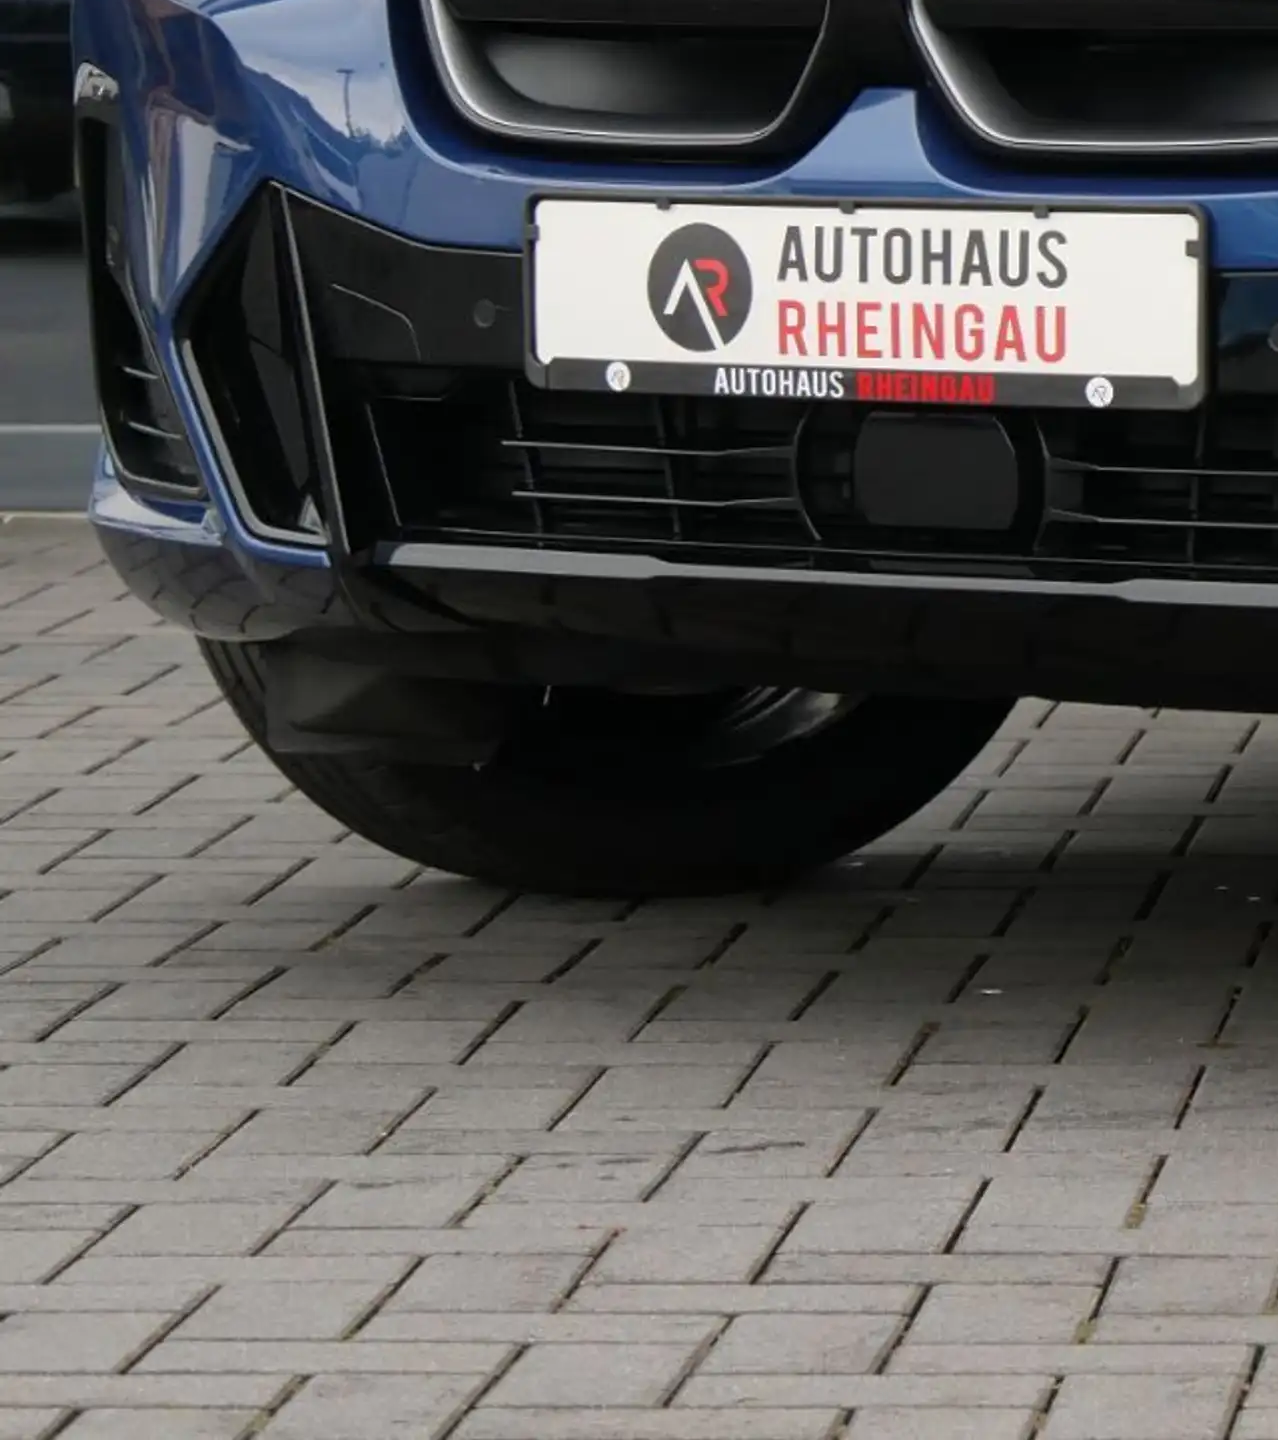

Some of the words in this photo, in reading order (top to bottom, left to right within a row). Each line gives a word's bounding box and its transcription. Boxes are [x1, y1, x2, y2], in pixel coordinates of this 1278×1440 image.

[777, 225, 1068, 288] AUTOHAUS
[778, 299, 1067, 363] RHEINGAU
[714, 366, 845, 399] AUTOHAUS
[856, 371, 996, 404] RHEINGAU
